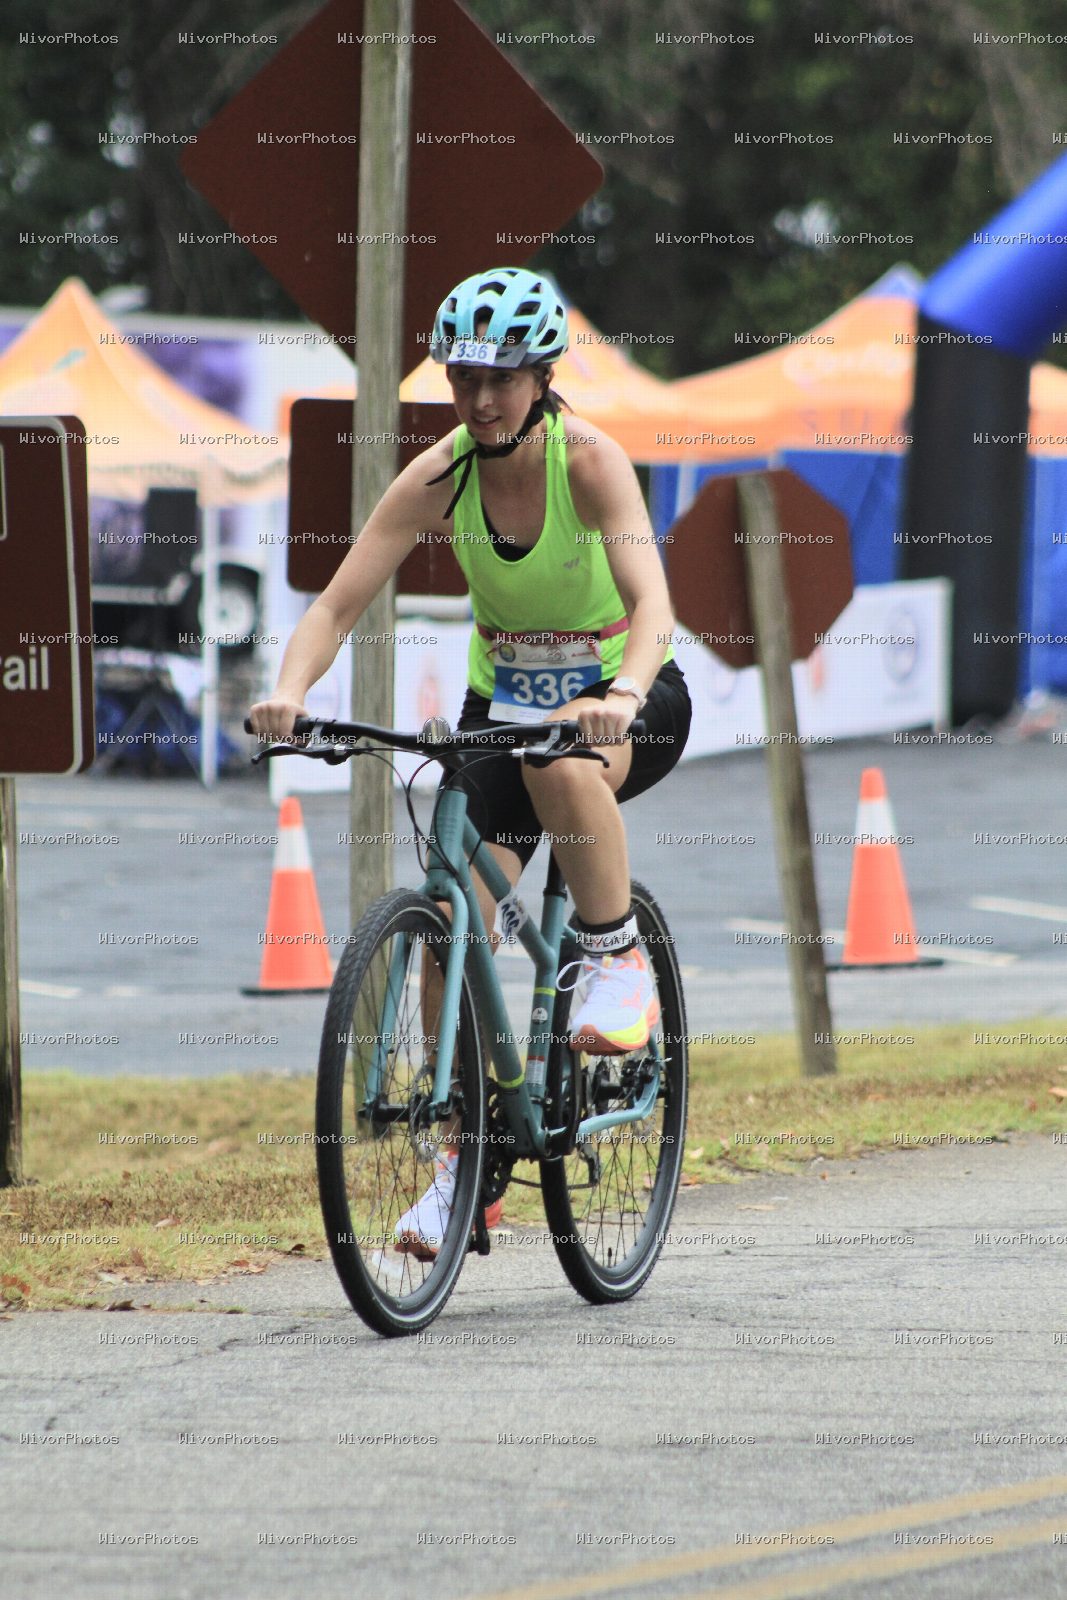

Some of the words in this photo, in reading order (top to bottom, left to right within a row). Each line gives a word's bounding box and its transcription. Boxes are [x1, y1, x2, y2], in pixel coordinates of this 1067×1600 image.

[457, 342, 488, 359] 336
[0, 645, 50, 691] ail
[511, 671, 585, 706] 336
